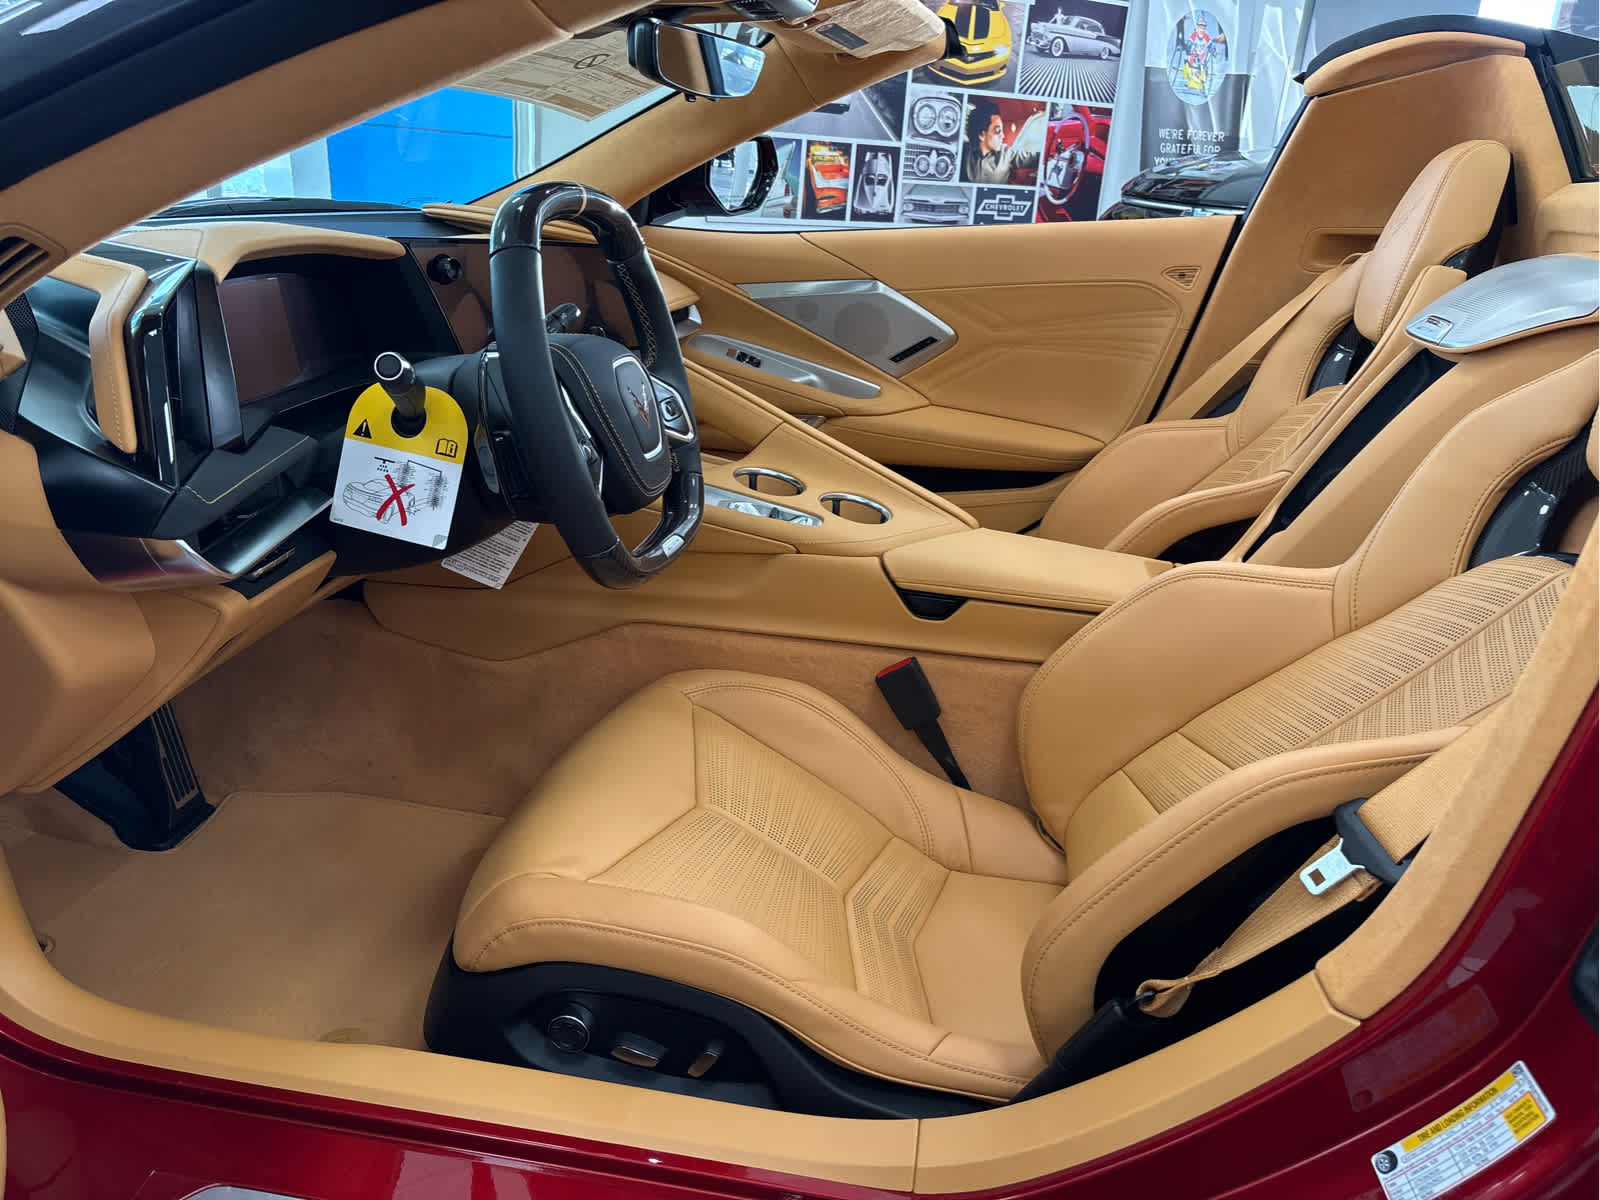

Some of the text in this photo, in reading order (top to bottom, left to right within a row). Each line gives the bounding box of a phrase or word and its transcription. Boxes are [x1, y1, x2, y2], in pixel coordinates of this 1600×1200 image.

[1158, 127, 1225, 143] WE'RE FOREVER
[1160, 142, 1202, 155] GRATEFUL
[984, 202, 1025, 212] CHEVROLET
[1416, 1129, 1432, 1142] TIRE
[1430, 1122, 1443, 1135] AND
[1441, 1109, 1465, 1129] LOADING
[1463, 1086, 1499, 1115] INFORMATION
